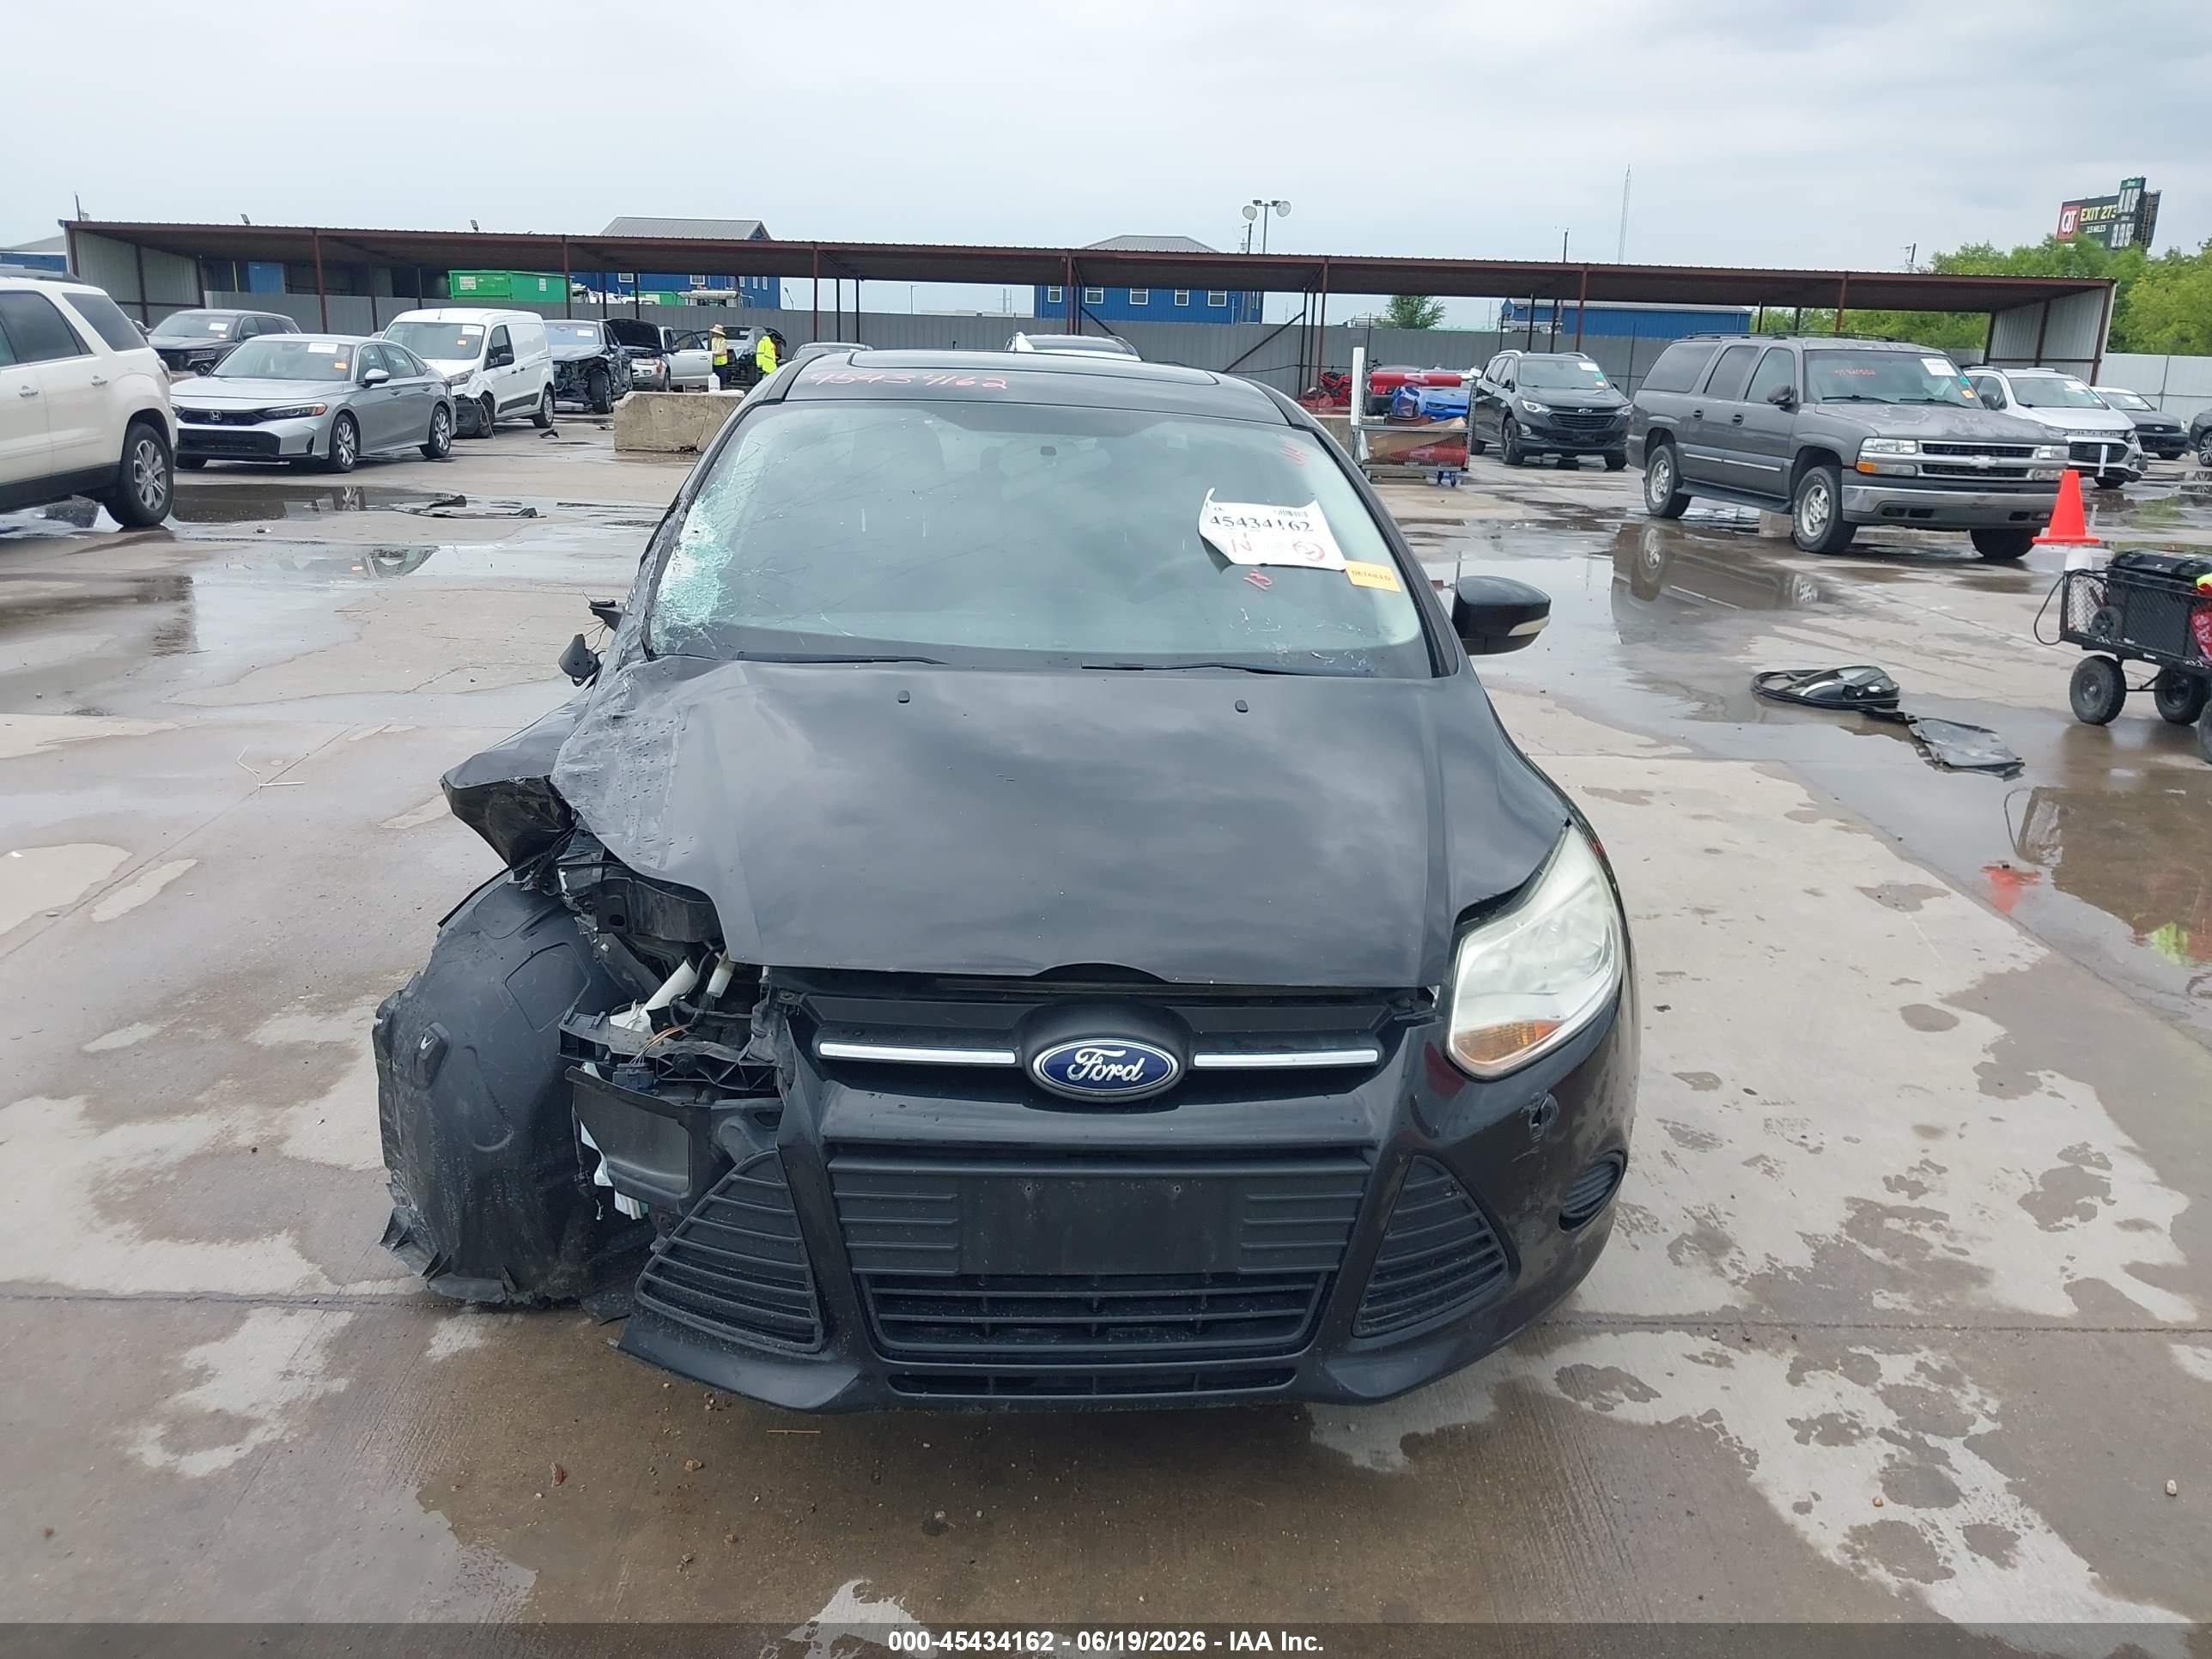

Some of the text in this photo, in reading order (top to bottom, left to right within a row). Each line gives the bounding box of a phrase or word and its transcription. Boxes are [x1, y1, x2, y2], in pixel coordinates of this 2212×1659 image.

[2062, 210, 2076, 234] QT
[2080, 207, 2100, 222] EXIT
[1209, 515, 1315, 533] 45434162
[1066, 1047, 1146, 1083] Ford
